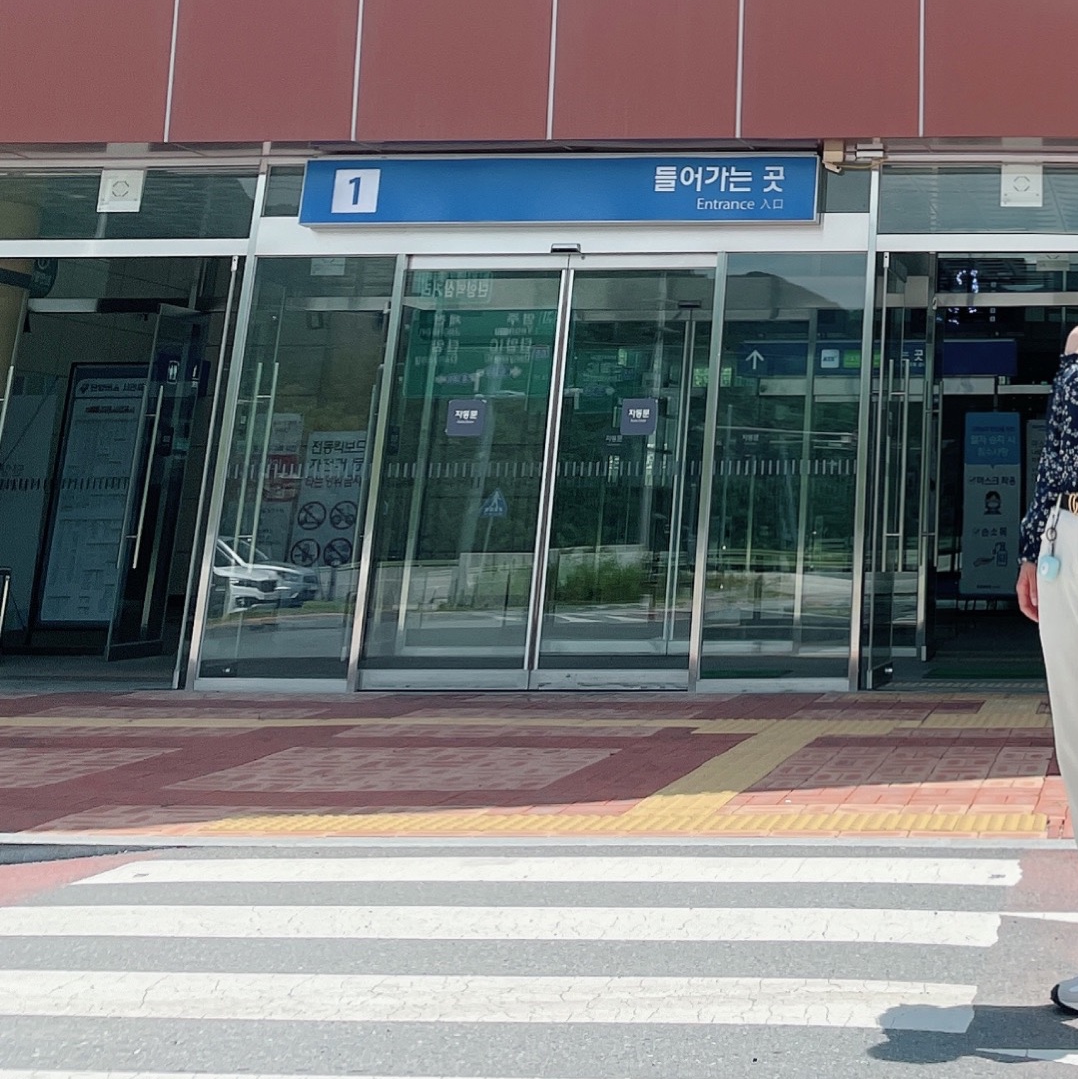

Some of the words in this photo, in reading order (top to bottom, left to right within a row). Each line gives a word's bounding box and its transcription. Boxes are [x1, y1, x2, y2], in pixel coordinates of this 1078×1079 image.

[347, 177, 362, 206] 1
[653, 165, 753, 193] 들어가는
[762, 165, 786, 193] 곳
[696, 197, 755, 211] Entrance
[760, 198, 784, 210] 入口
